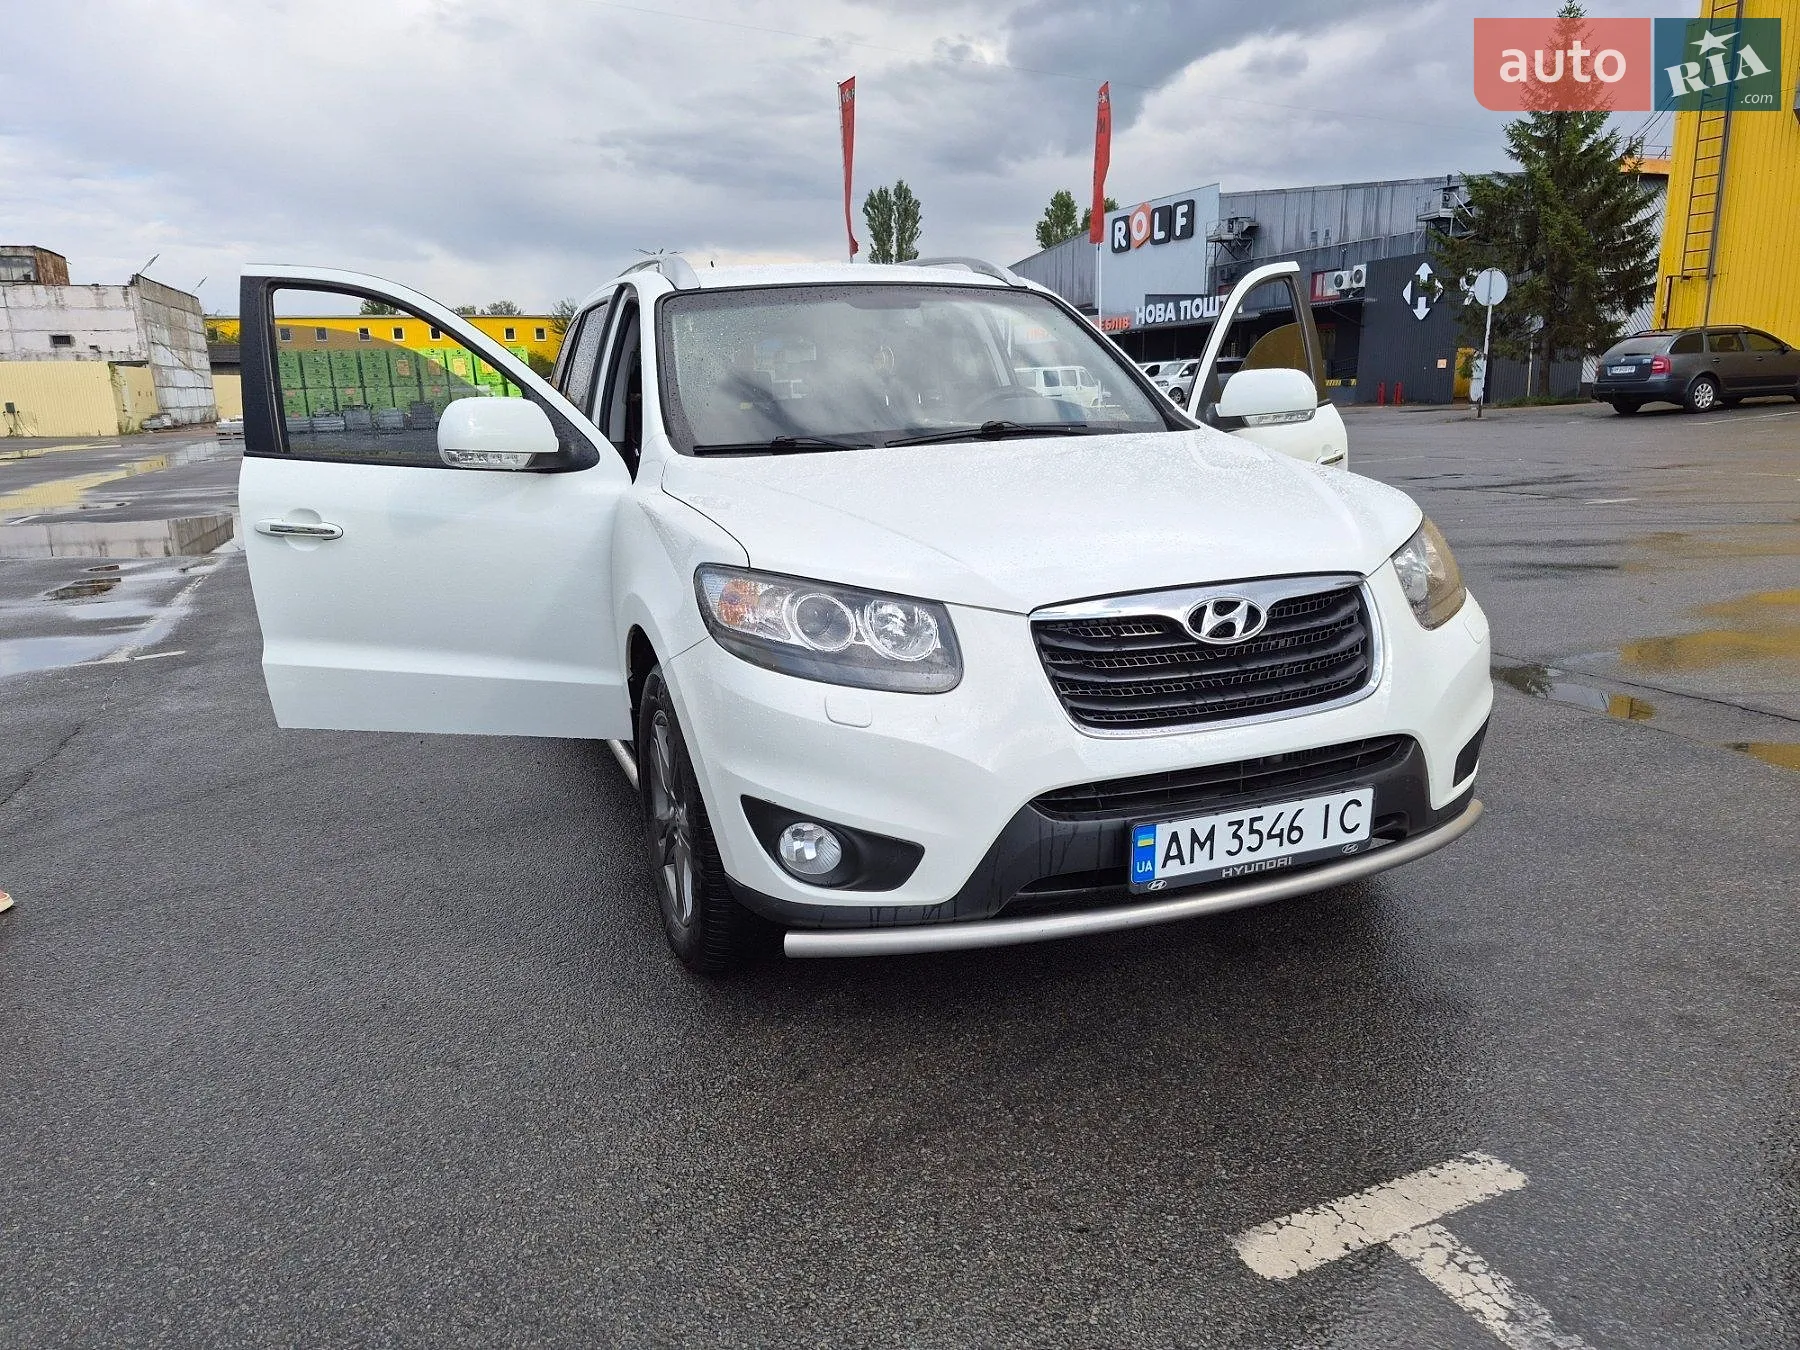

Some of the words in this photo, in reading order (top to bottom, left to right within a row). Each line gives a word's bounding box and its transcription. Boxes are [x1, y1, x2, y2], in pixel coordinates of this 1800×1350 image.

[1113, 204, 1189, 249] ROLF
[1135, 302, 1176, 325] НОВА
[1179, 294, 1243, 320] ПОШ
[1093, 316, 1131, 332] ЕБЛІВ
[1160, 823, 1216, 869] AM
[1225, 807, 1305, 857] 3546
[1321, 798, 1363, 840] IC
[1136, 861, 1154, 874] UA
[1221, 856, 1293, 879] HYUNDAI
